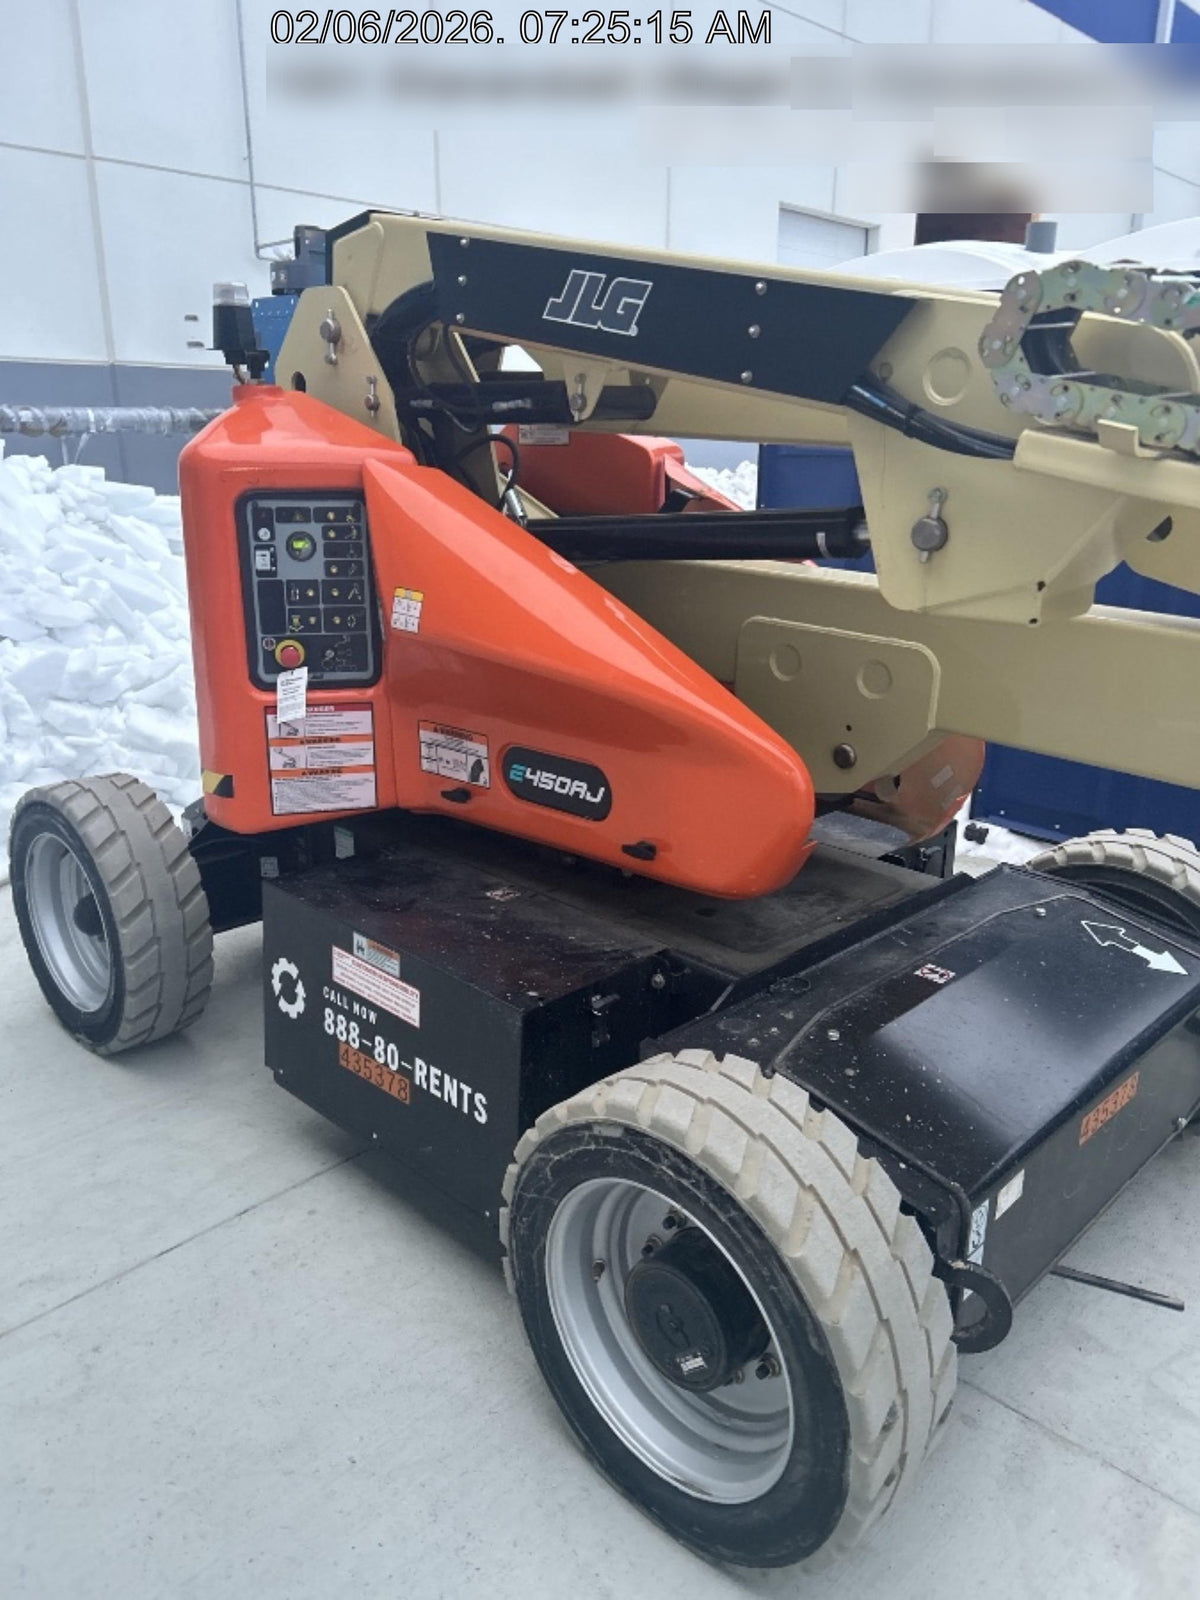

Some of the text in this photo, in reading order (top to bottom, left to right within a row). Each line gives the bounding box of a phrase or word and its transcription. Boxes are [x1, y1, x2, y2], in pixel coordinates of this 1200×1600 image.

[542, 269, 653, 336] JLG
[510, 763, 605, 803] E450AJ
[323, 986, 377, 1025] CALL NOW
[324, 1007, 488, 1124] 888-80-RENTS
[340, 1046, 409, 1102] 435378
